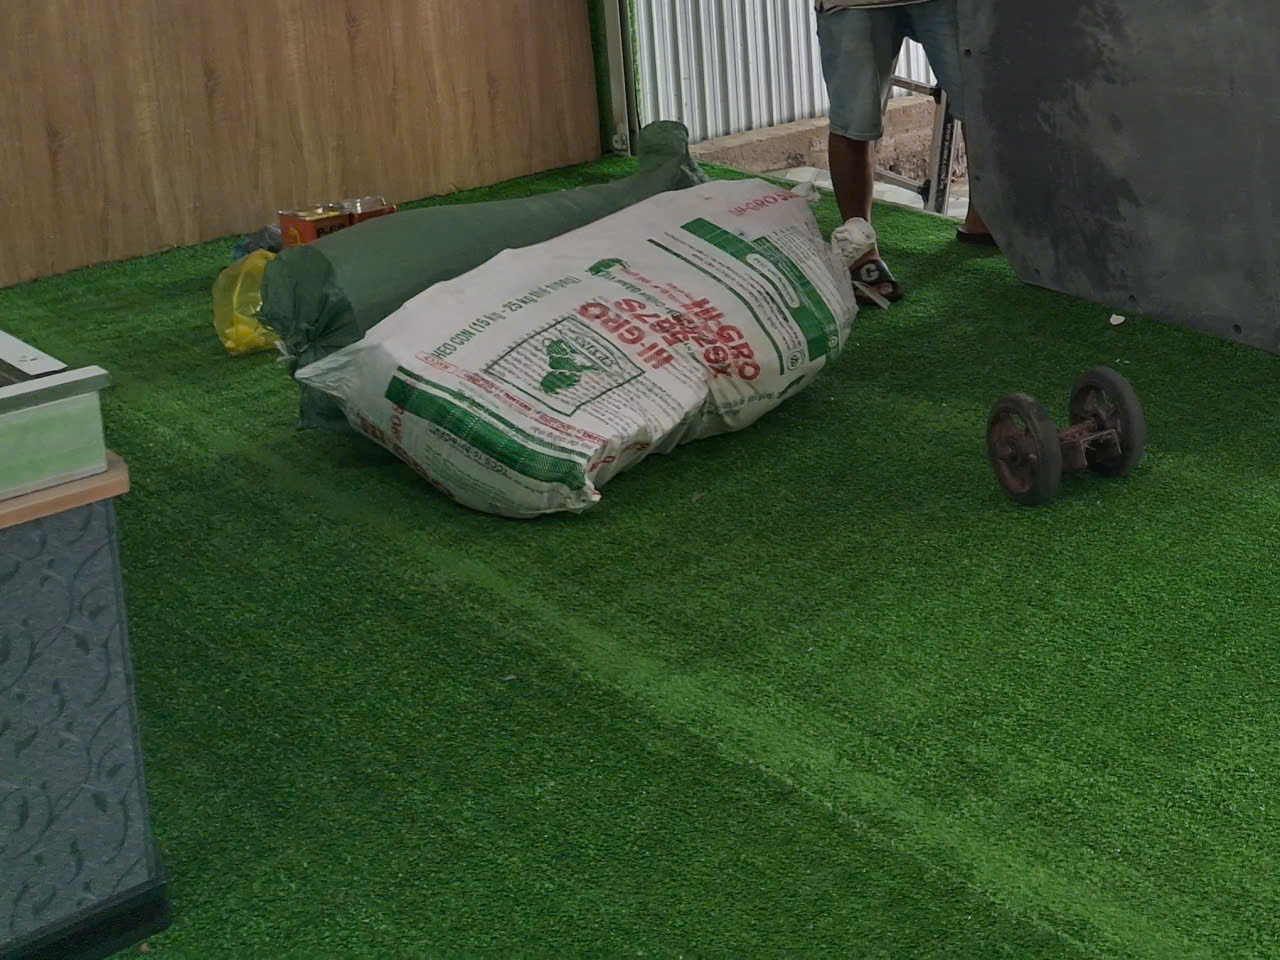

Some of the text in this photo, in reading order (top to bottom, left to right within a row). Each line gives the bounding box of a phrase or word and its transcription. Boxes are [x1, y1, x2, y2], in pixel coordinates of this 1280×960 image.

[432, 342, 457, 359] HEO
[578, 301, 675, 369] HI-GRO
[681, 297, 761, 381] HI-GRO
